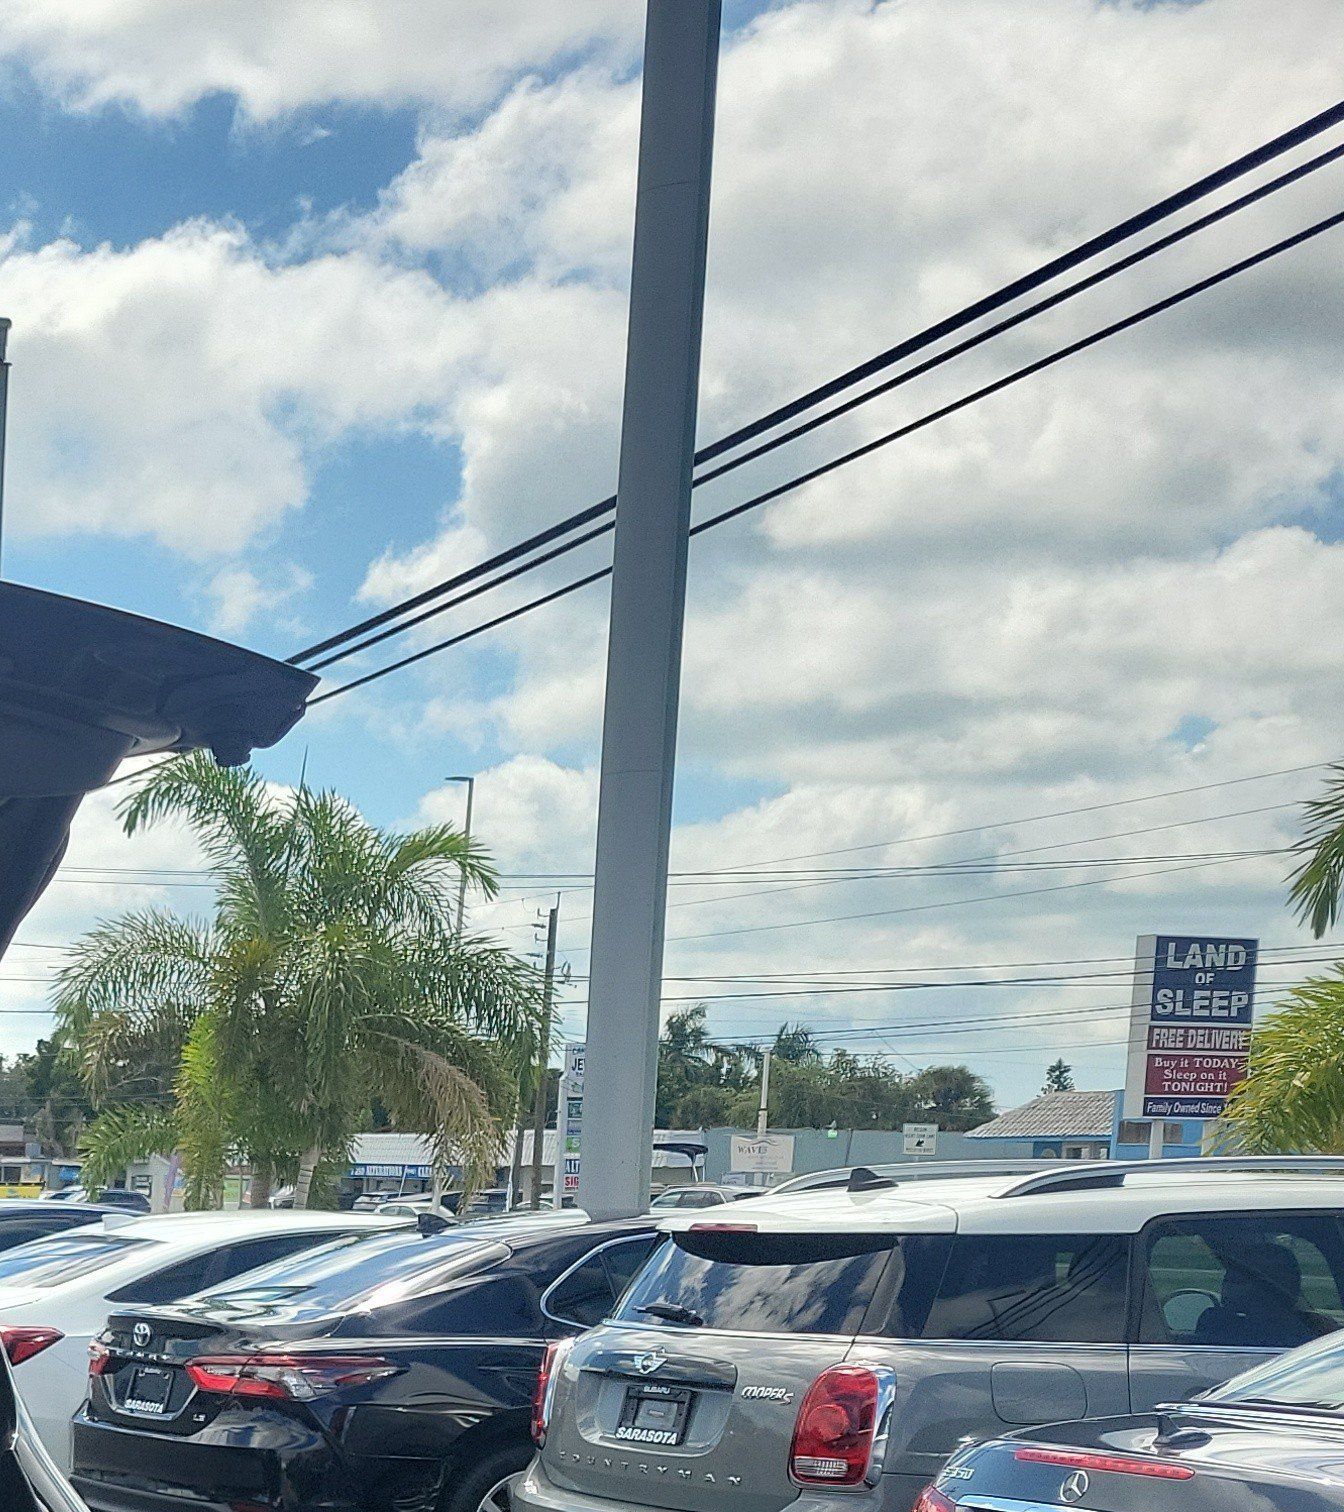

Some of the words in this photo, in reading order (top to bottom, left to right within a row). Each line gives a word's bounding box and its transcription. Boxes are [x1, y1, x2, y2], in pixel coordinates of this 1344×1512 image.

[1166, 942, 1246, 971] LAND
[1195, 972, 1215, 985] OF
[1155, 988, 1249, 1018] SLEEP
[1152, 1028, 1184, 1049] FREE
[1154, 1057, 1178, 1069] Buy
[1180, 1059, 1189, 1067] it
[1193, 1058, 1238, 1069] TODAY
[1163, 1069, 1196, 1081] Sleep
[1200, 1072, 1215, 1080] on
[1218, 1071, 1227, 1080] it
[1162, 1082, 1228, 1093] TONIGHT!
[1146, 1102, 1172, 1116] Family
[1173, 1102, 1201, 1114] Owned
[1201, 1102, 1222, 1114] Since
[615, 1426, 678, 1445] SARASOTA
